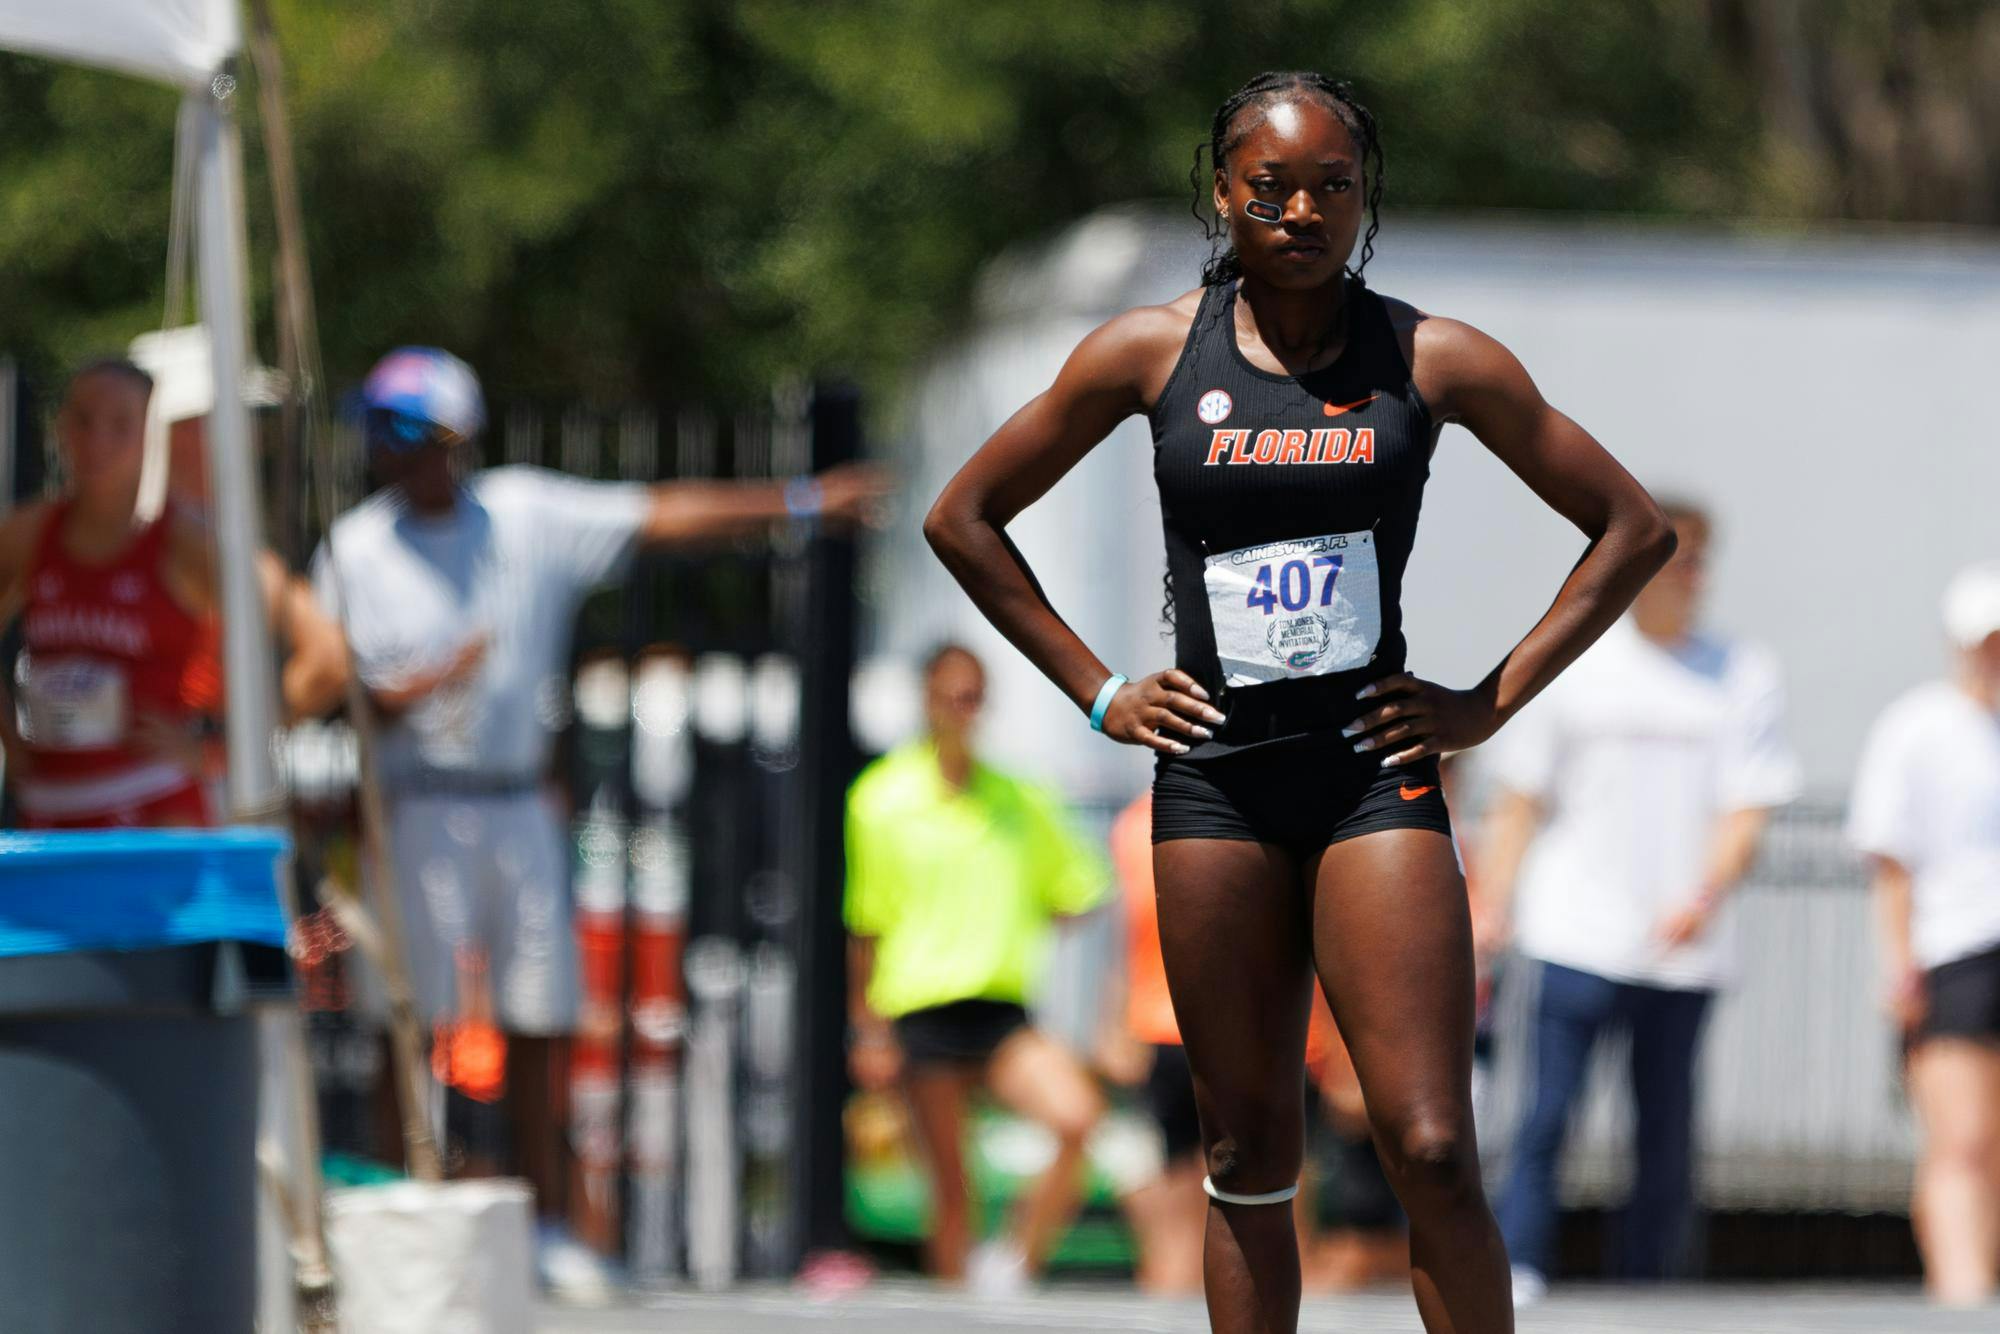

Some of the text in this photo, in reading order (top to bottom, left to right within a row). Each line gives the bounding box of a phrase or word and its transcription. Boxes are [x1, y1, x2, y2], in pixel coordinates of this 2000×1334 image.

[1200, 391, 1231, 421] SEC
[1203, 428, 1374, 465] FLORIDA
[1328, 536, 1348, 549] FL
[1247, 554, 1343, 615] 407
[1281, 624, 1314, 638] MEMORIAL
